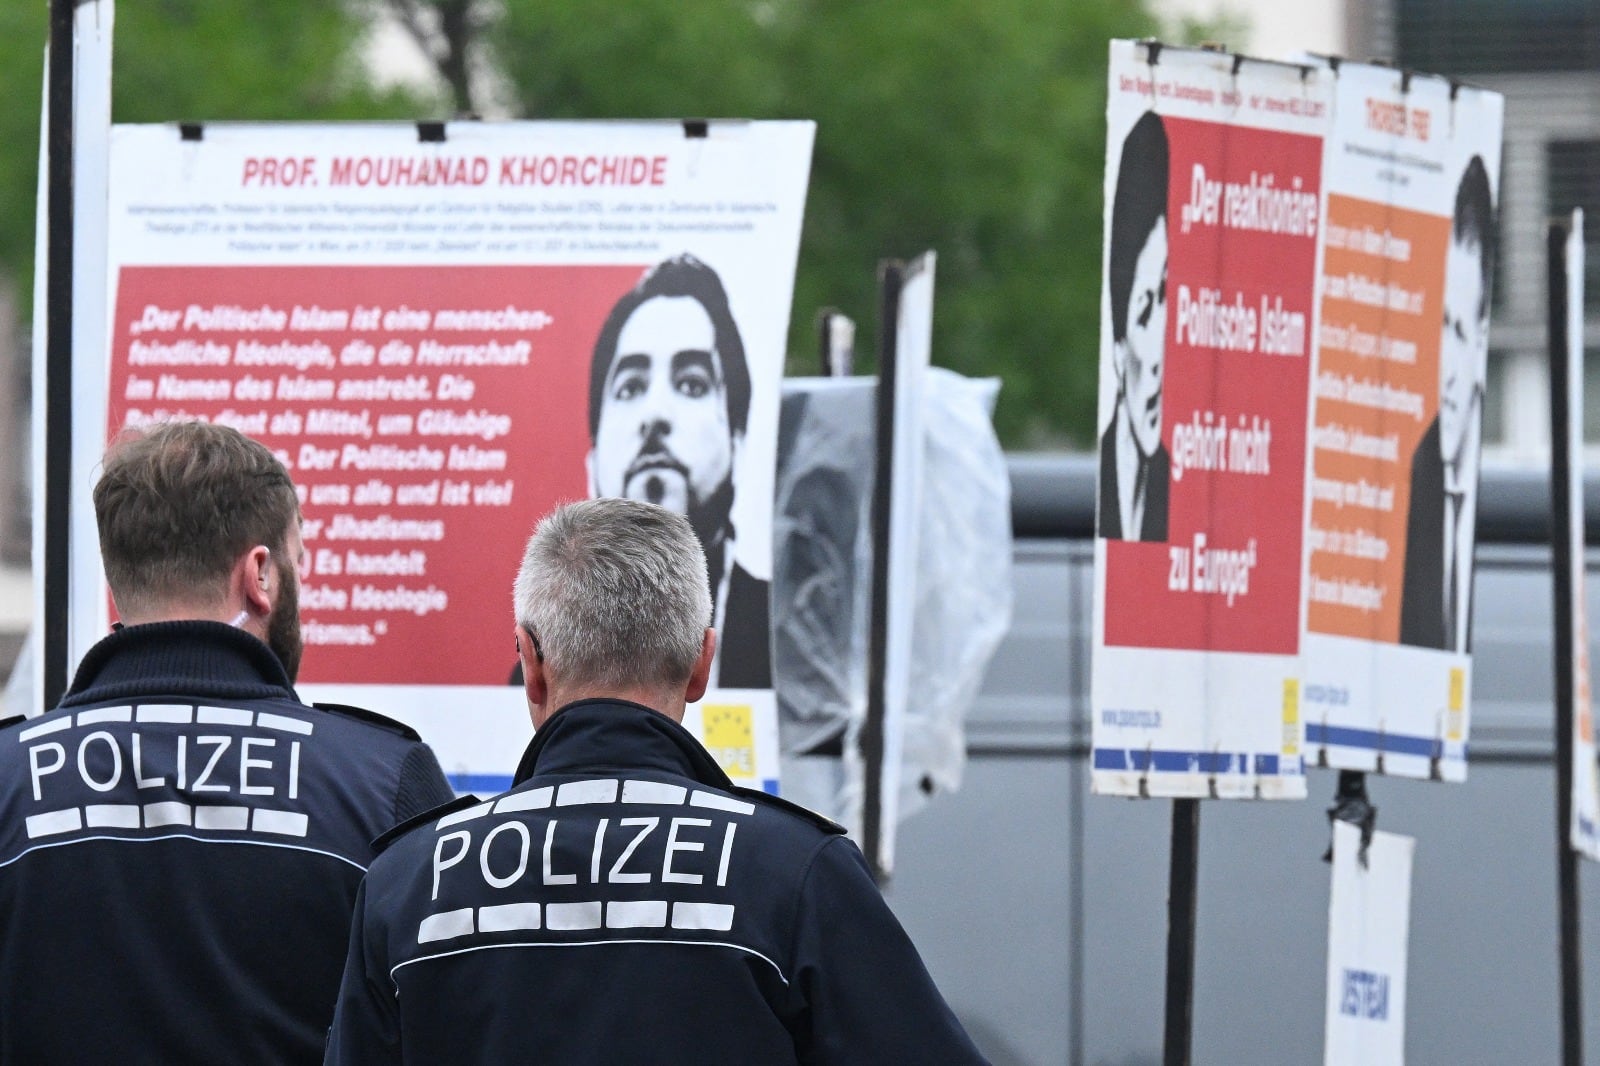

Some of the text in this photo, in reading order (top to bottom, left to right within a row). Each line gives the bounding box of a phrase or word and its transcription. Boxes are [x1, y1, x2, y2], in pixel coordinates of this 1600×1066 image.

[243, 155, 667, 187] PROF. MOUHANAD KHORCHIDE
[1223, 171, 1318, 239] reaktionäre
[184, 304, 288, 331] Politische
[290, 305, 349, 331] Islam
[351, 305, 381, 331] ist
[383, 306, 431, 331] eine
[433, 305, 553, 331] menschen-
[1176, 285, 1257, 353] Politische
[1260, 294, 1305, 356] Islam
[127, 339, 532, 370] feindliche Ideologie, die die Herrschaft
[124, 374, 475, 401] im Namen des Islam anstrebt. Die
[212, 409, 268, 435] dient
[269, 409, 302, 435] als
[304, 409, 373, 440] Mittel,
[376, 413, 413, 435] um
[415, 408, 512, 440] Gläubige
[297, 443, 339, 470] Der
[340, 444, 445, 470] Politische
[447, 444, 507, 470] Islam
[1171, 410, 1227, 482] gehört
[1228, 415, 1271, 475] nicht
[310, 484, 351, 505] uns
[352, 479, 393, 505] alle
[395, 479, 440, 505] und
[441, 479, 471, 506] ist
[472, 479, 513, 506] viel
[324, 513, 444, 541] Jihadismus
[314, 549, 342, 575] Es
[344, 549, 427, 576] handelt
[1168, 545, 1190, 592] zu
[350, 584, 447, 615] Ideologie
[29, 731, 300, 801] POLIZEI
[431, 816, 737, 901] POLIZEI
